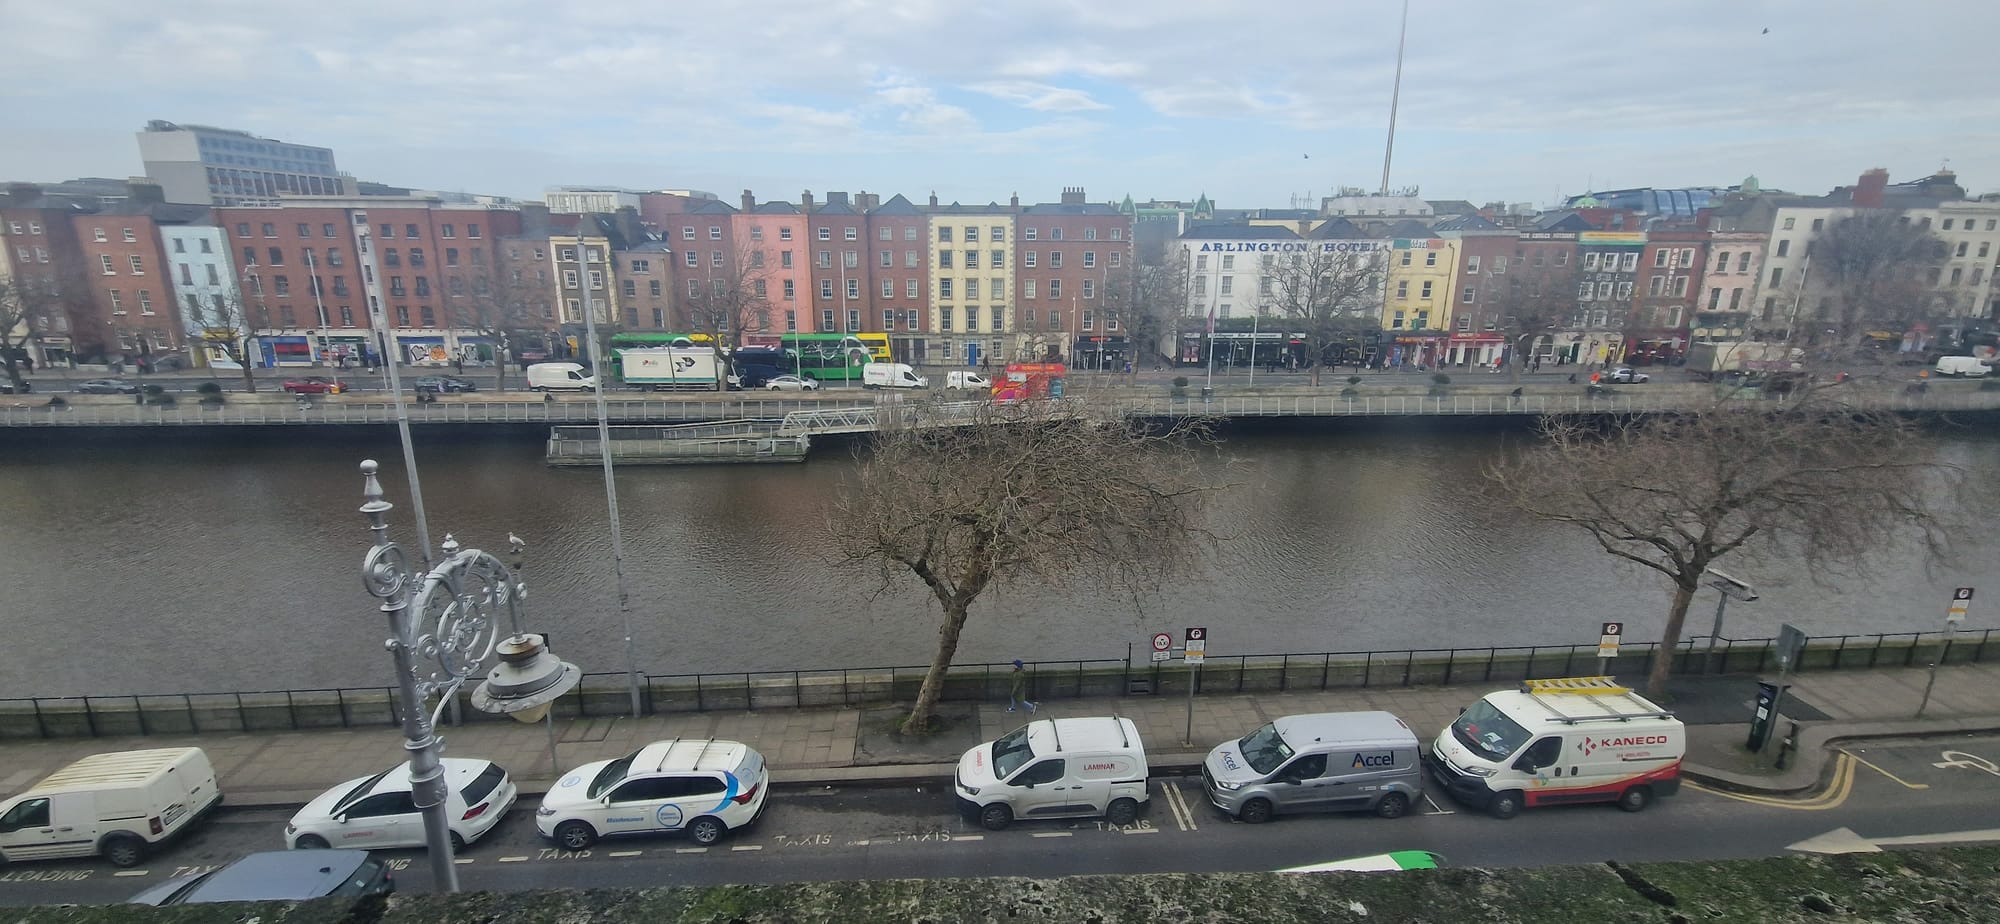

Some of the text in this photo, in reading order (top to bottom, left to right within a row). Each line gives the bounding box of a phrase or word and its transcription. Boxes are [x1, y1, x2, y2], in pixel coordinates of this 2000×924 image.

[1200, 242, 1380, 252] ARLINGTON HOTEL
[1601, 735, 1668, 747] KANECO
[1219, 751, 1241, 771] Accel
[1351, 751, 1395, 769] Accel
[1083, 763, 1116, 771] LAMINAR
[0, 869, 94, 882] LOADING
